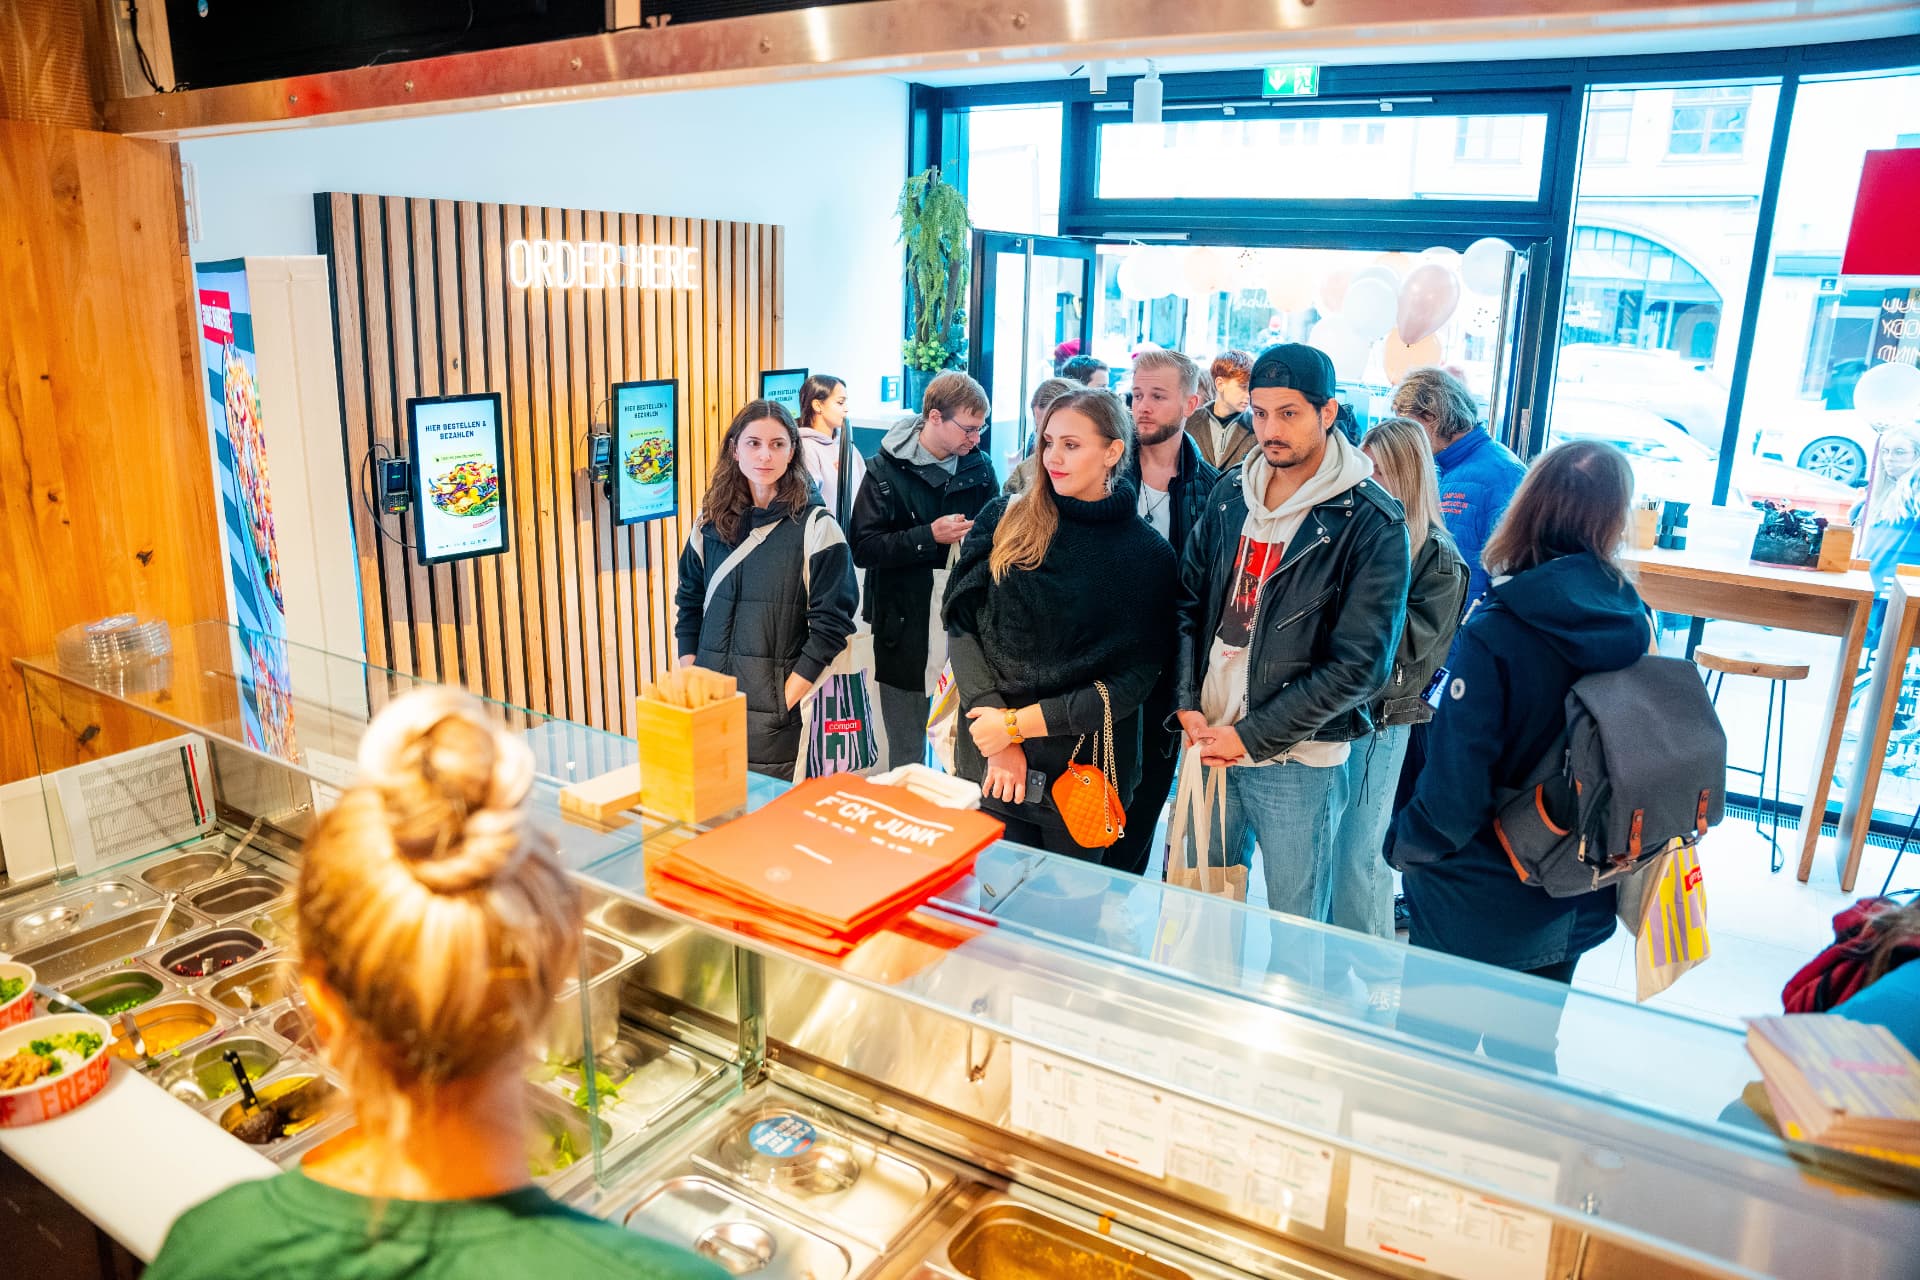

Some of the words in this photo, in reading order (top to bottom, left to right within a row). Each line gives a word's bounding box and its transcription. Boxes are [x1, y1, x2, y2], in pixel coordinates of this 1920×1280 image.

[509, 239, 617, 289] ORDER
[627, 243, 700, 290] HERE
[425, 424, 441, 432] HIER
[442, 420, 481, 431] BESTELLEN
[439, 430, 475, 440] BEZAHLEN
[873, 817, 945, 848] JUNK
